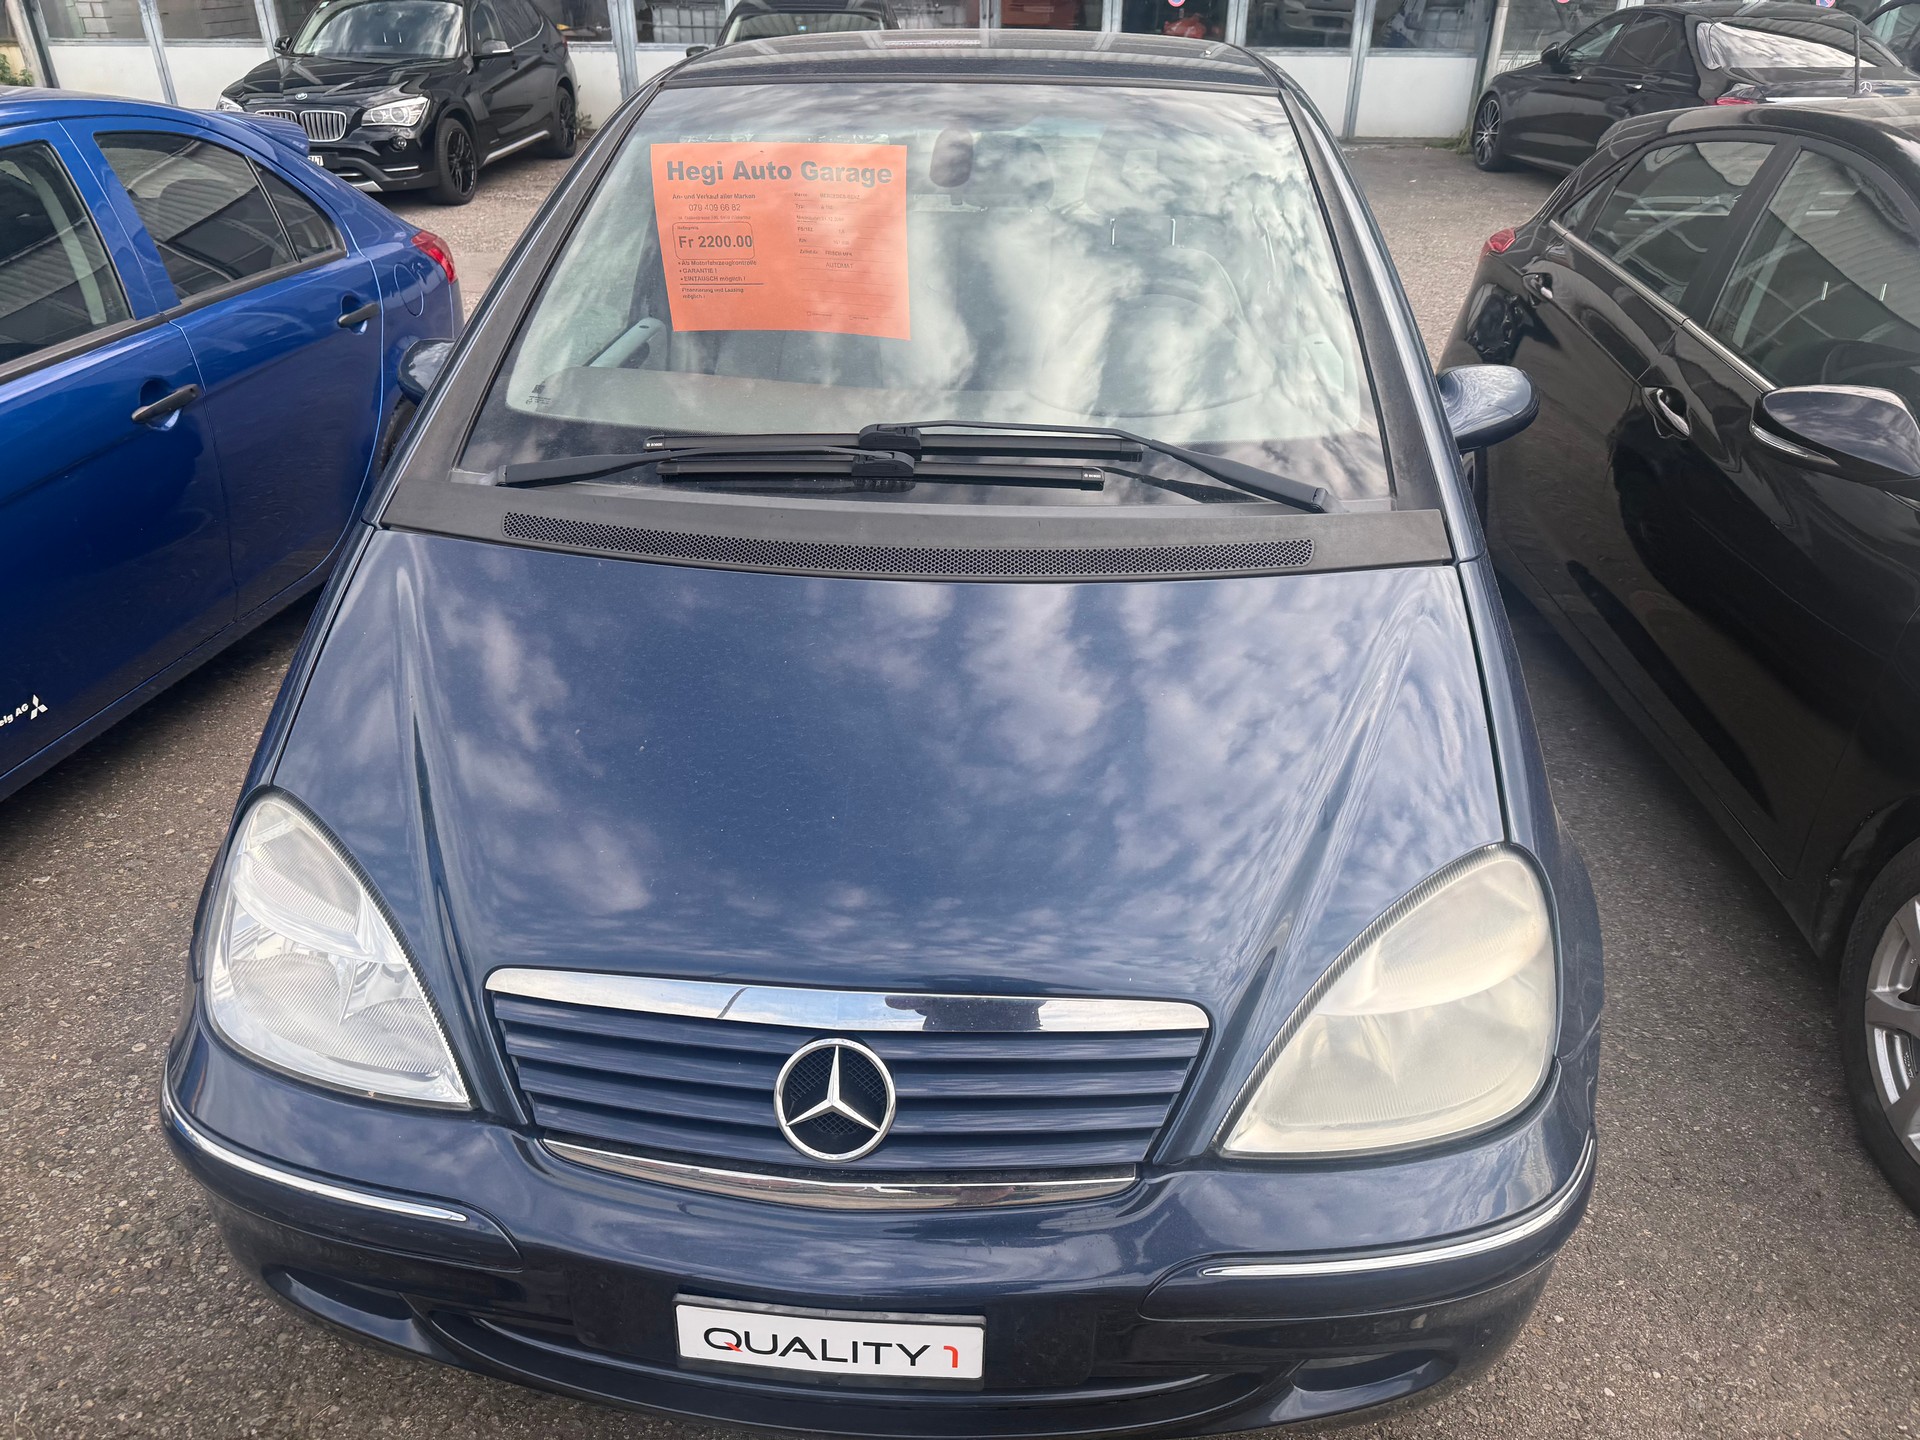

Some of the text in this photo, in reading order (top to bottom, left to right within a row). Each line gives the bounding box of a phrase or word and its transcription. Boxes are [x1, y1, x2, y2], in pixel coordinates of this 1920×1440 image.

[667, 160, 893, 188] Hegi Auto Garage
[688, 203, 741, 212] 079 409 66 82
[678, 234, 754, 249] Fr 2200.00
[719, 275, 743, 283] möglich
[15, 703, 29, 717] AG
[703, 1327, 959, 1369] QUALITY 1
